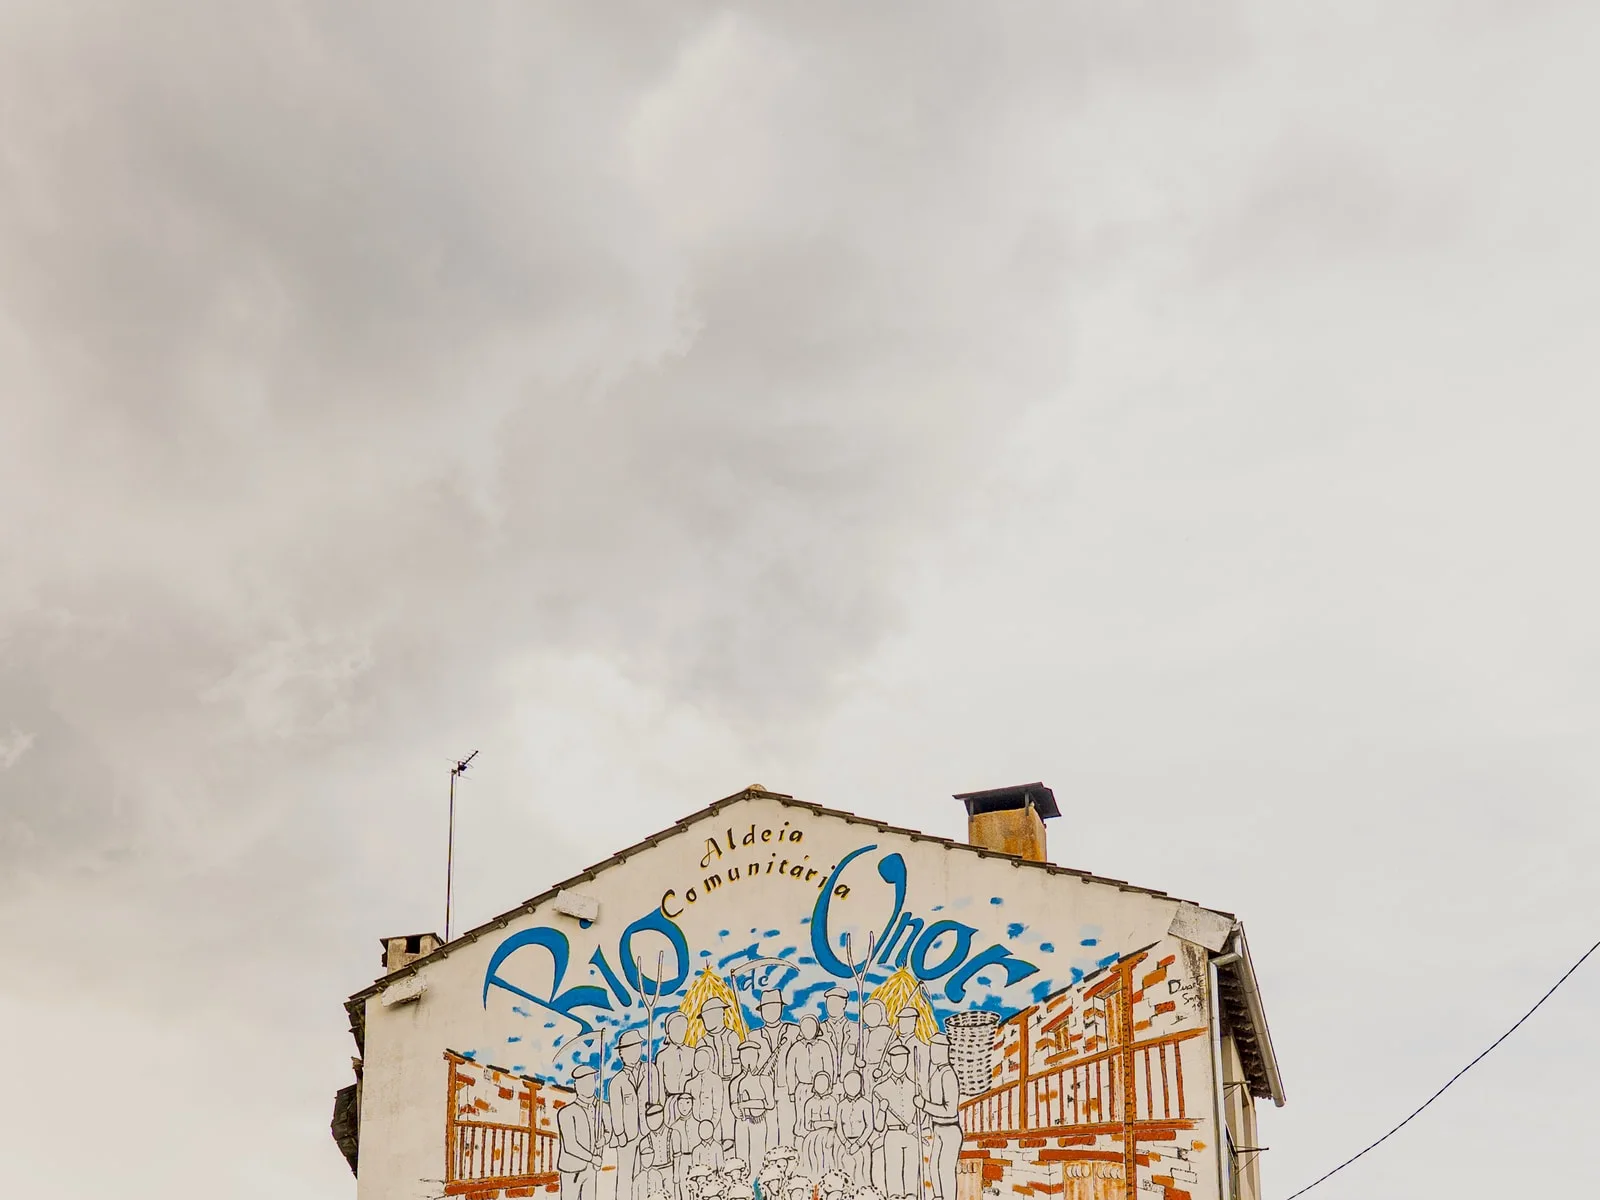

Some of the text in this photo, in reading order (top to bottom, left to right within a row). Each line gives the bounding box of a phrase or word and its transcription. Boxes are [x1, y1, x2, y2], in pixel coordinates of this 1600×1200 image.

[700, 821, 804, 868] Aldeia
[661, 852, 851, 918] Comunitária
[742, 968, 769, 991] de
[811, 844, 1041, 1003] Onor
[1168, 974, 1205, 994] Duarte
